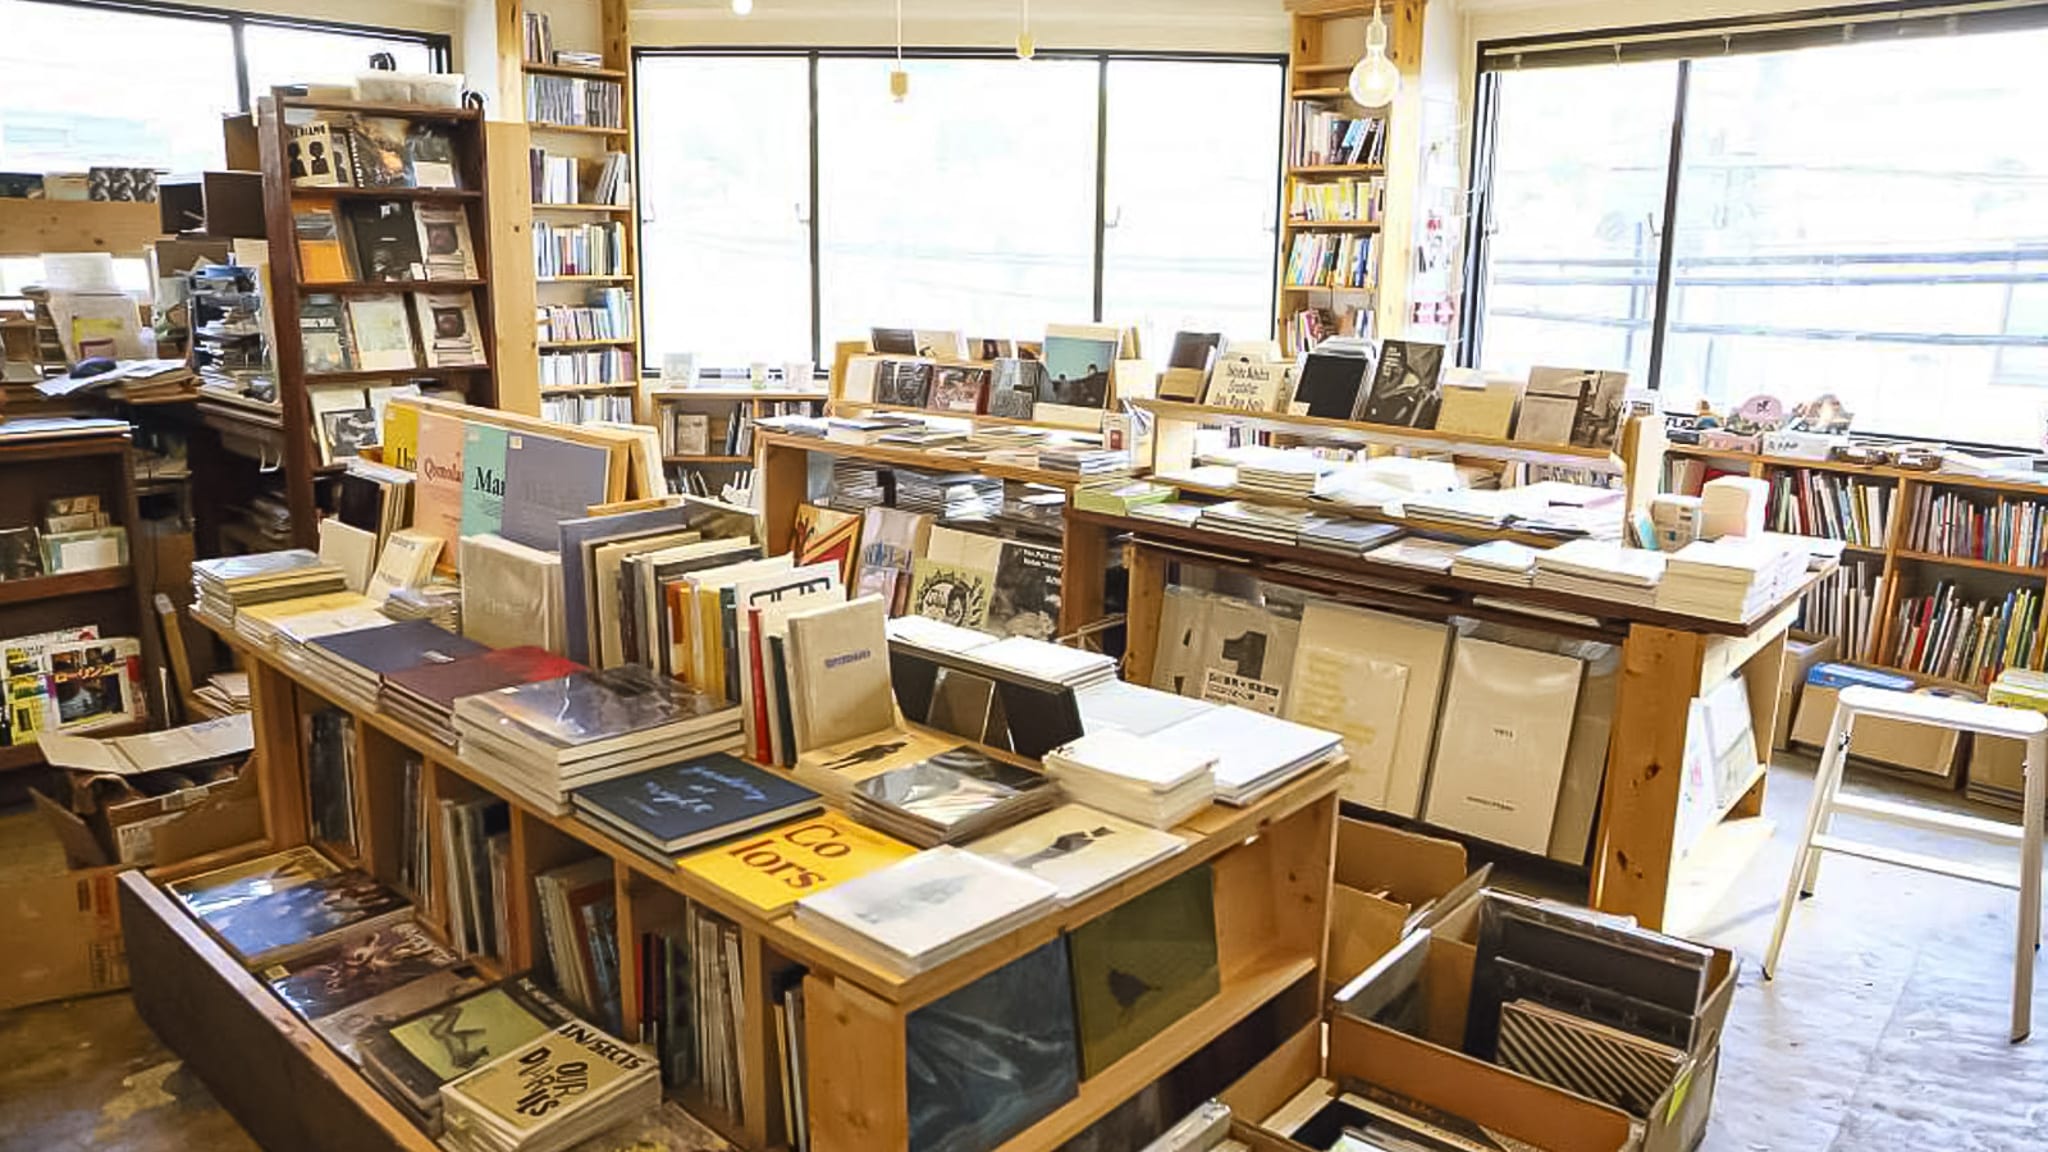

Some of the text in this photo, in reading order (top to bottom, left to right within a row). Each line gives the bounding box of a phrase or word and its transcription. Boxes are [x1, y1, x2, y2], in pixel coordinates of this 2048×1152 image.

[784, 823, 851, 858] Co
[728, 838, 827, 890] lors
[552, 1060, 589, 1099] OUR
